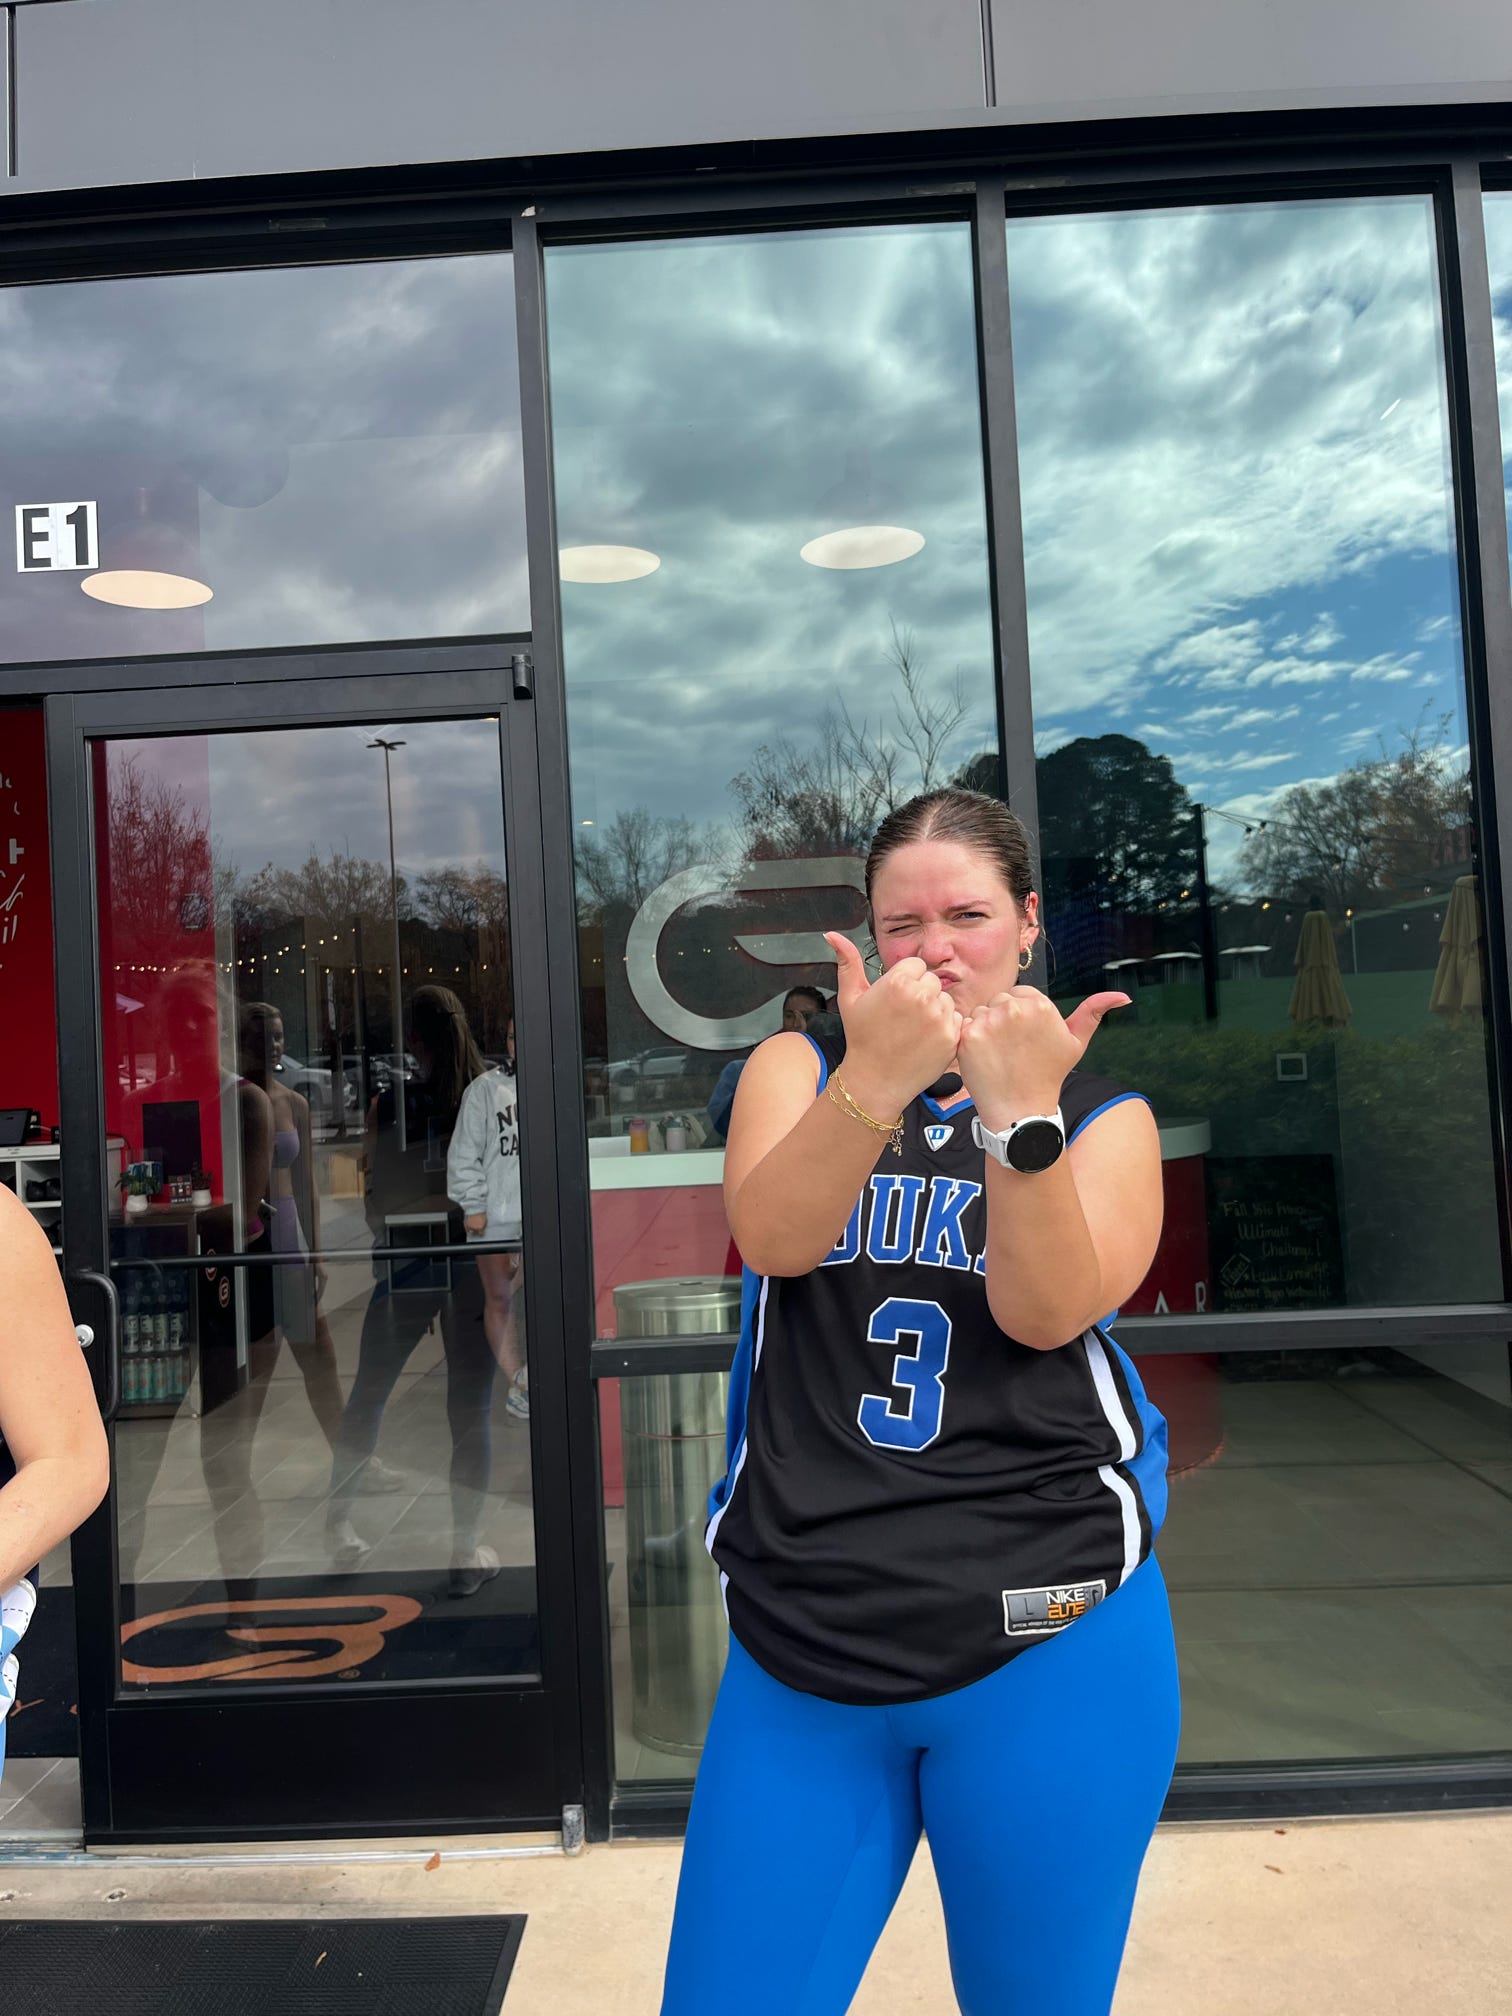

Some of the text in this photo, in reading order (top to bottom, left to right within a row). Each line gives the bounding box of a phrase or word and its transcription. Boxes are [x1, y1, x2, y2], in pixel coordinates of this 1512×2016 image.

[22, 505, 90, 569] E1
[496, 1103, 519, 1134] N
[817, 1174, 986, 1277] UK
[856, 1296, 953, 1453] 3
[1024, 1597, 1035, 1615] L
[1045, 1588, 1085, 1604] NIKE
[1047, 1602, 1086, 1619] ELITE
